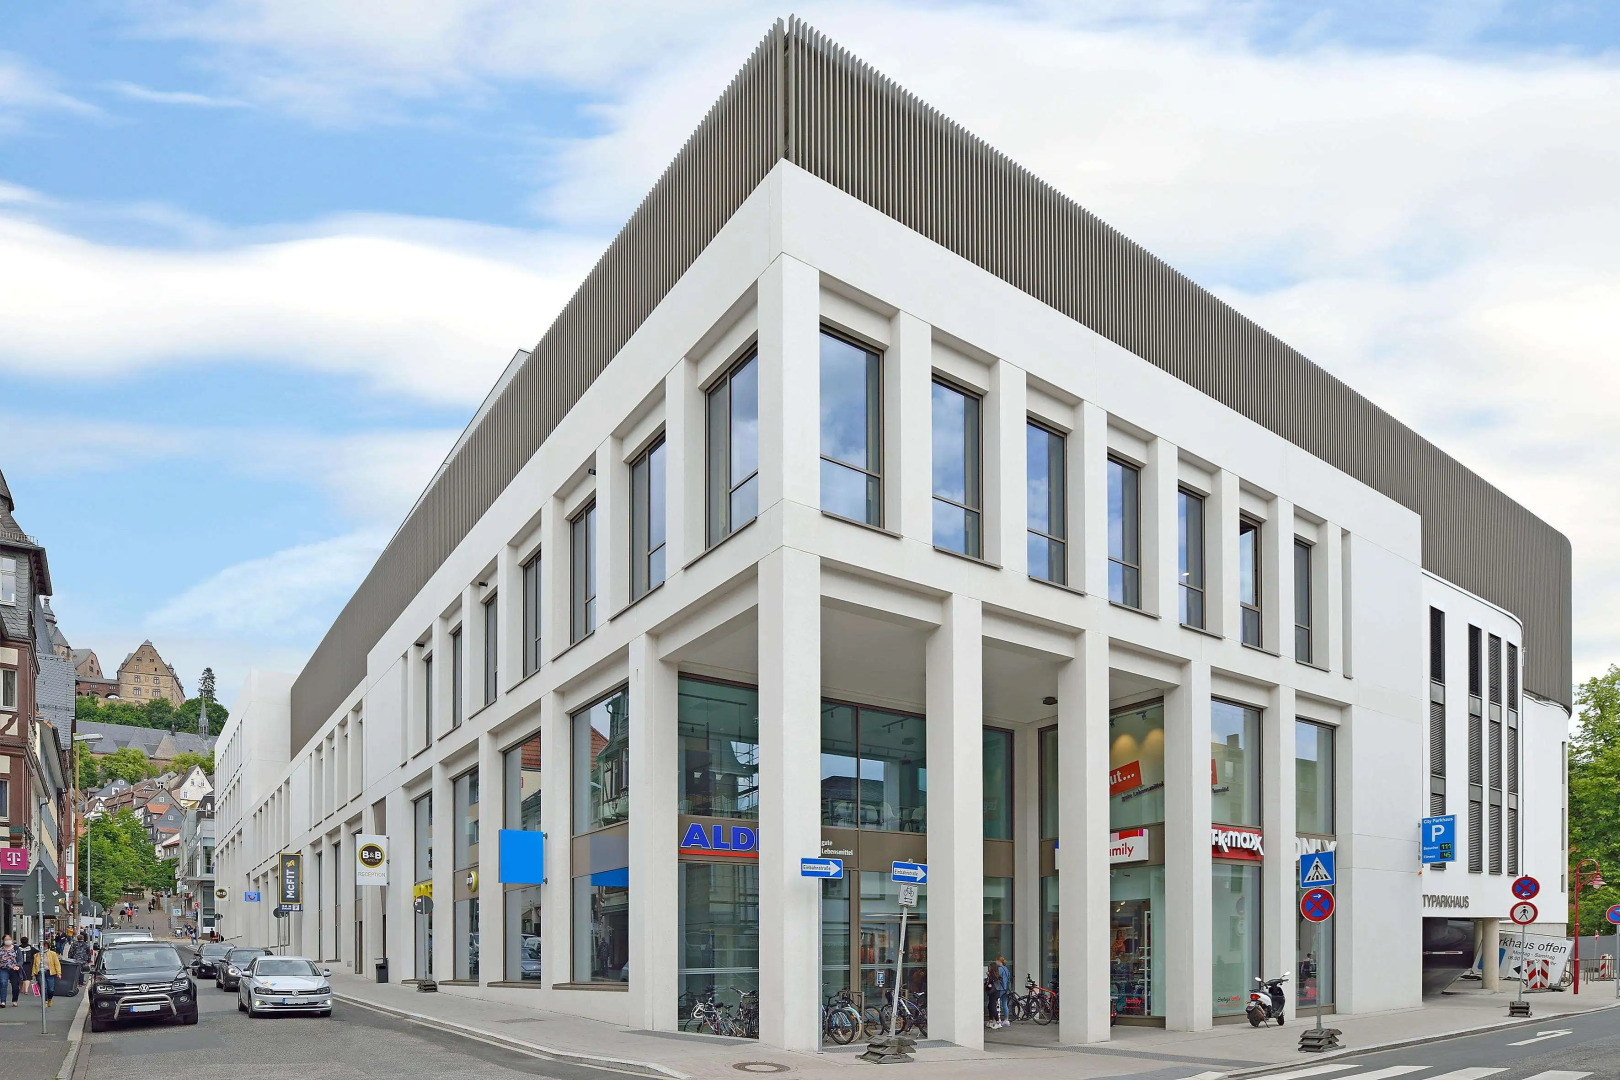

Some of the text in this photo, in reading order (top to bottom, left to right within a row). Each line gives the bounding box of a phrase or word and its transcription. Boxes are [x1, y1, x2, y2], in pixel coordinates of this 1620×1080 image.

[1431, 824, 1445, 842] P
[362, 850, 382, 860] B&B
[821, 847, 854, 856] Lebensmittel
[1109, 841, 1134, 857] mily
[7, 851, 21, 866] T
[1421, 894, 1470, 909] TYPARKHAUS
[1537, 942, 1567, 954] offen
